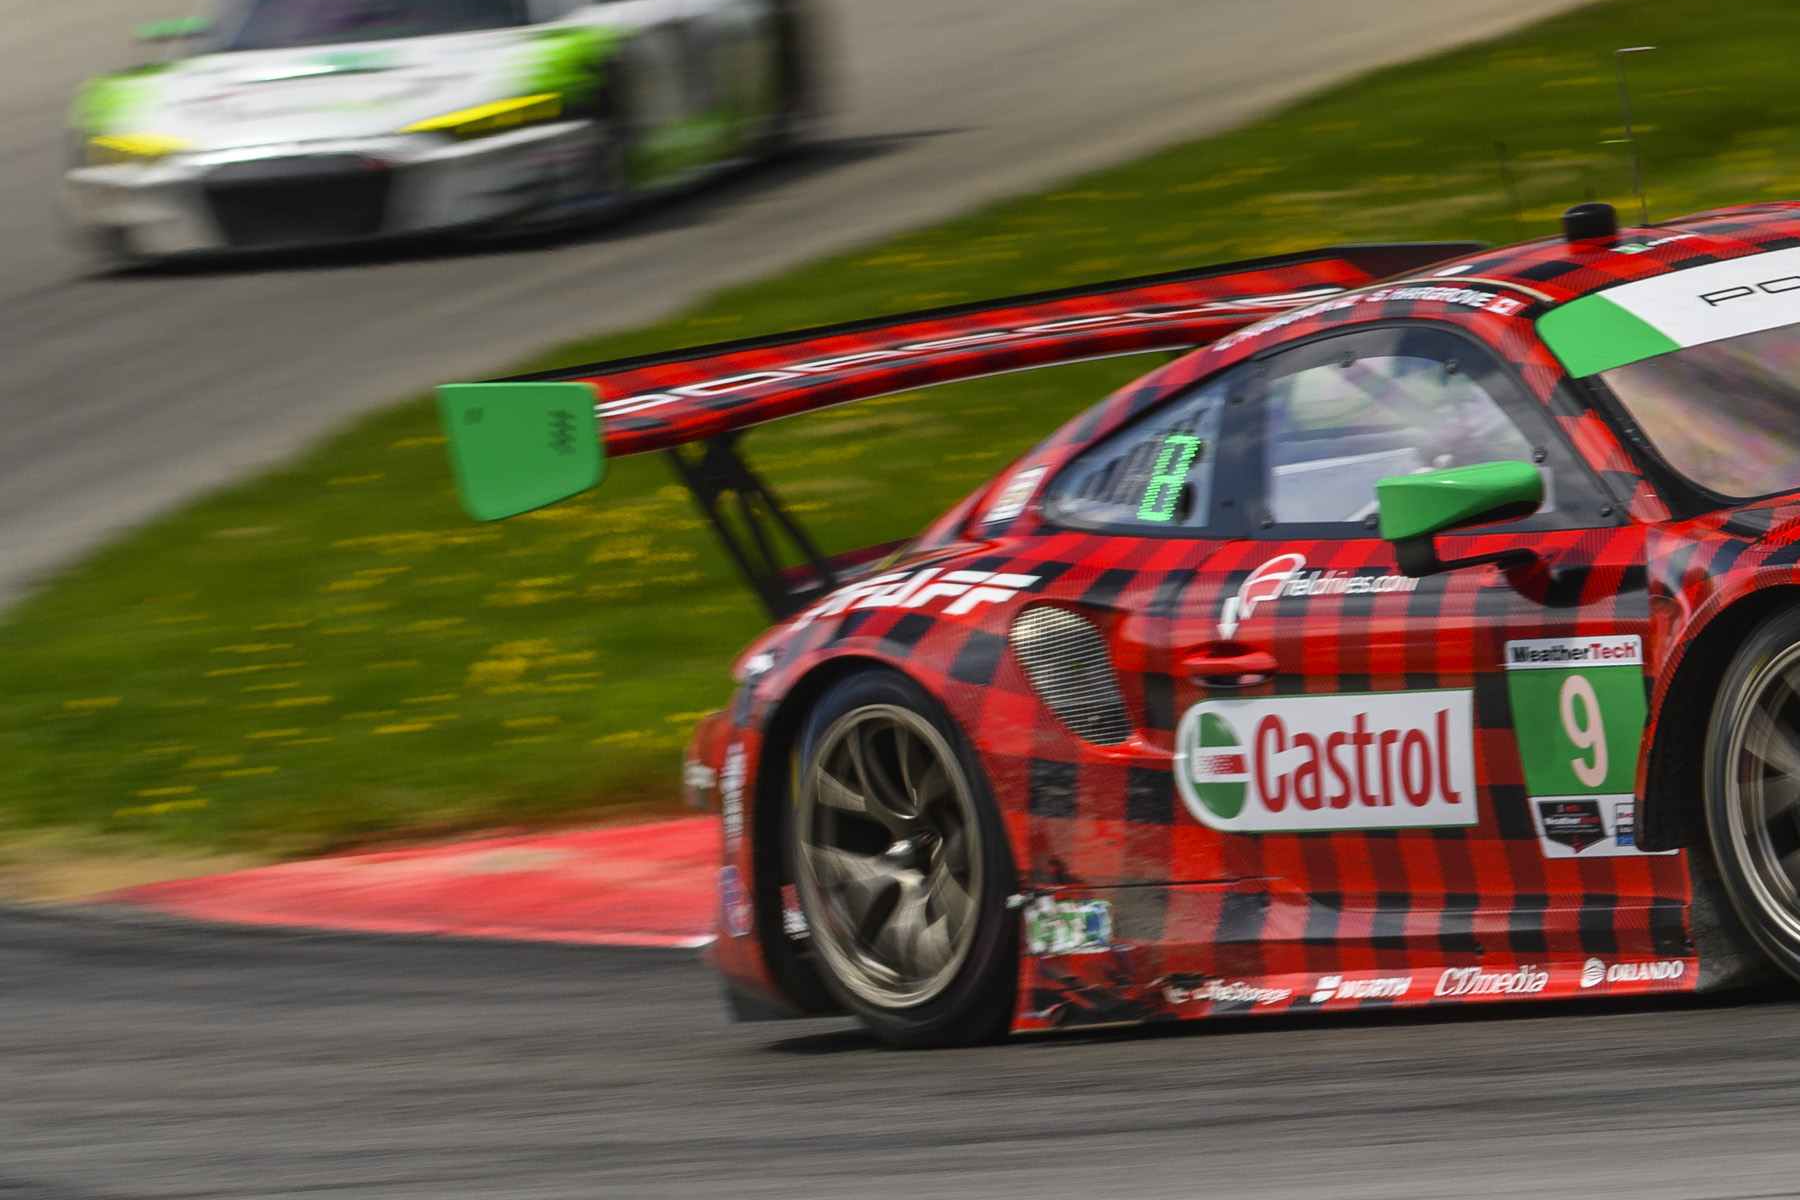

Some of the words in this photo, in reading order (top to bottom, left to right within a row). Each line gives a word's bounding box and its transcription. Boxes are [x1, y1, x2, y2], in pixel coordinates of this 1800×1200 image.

[1510, 642, 1637, 663] WeatherTech
[1255, 708, 1462, 813] Castrol
[1559, 675, 1608, 787] 9
[1607, 960, 1685, 982] ORLANDO
